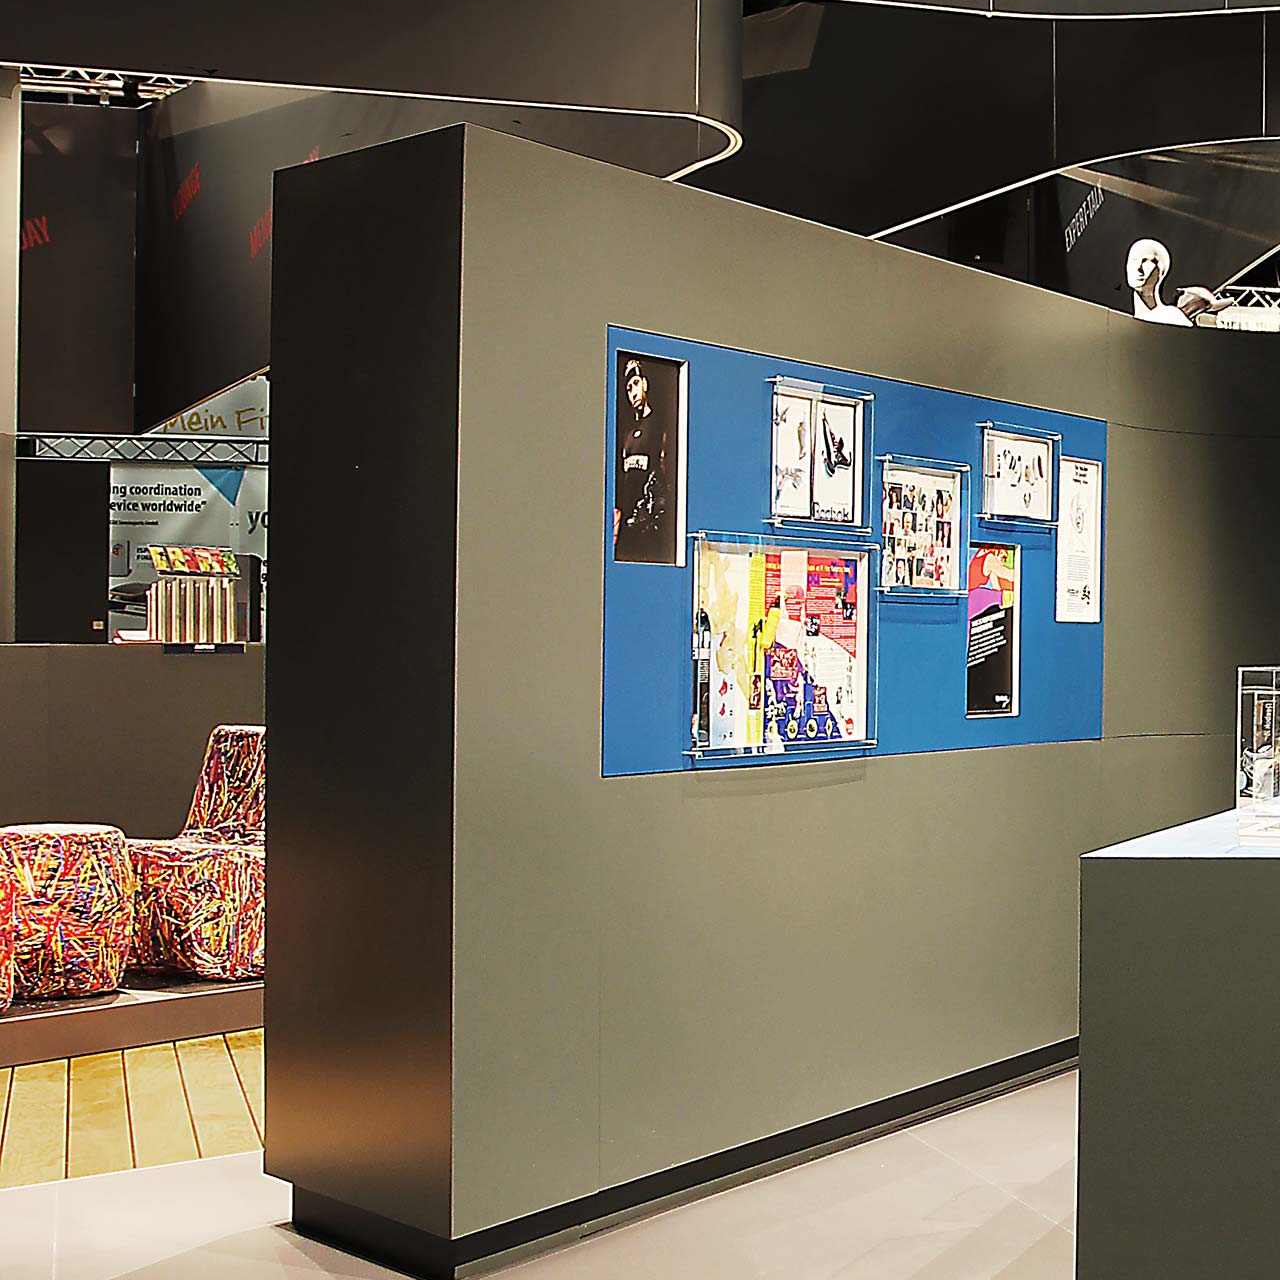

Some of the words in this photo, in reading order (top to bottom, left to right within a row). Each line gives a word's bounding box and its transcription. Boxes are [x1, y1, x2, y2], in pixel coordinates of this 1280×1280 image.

[1064, 178, 1105, 253] EXPERT-TALK
[235, 407, 268, 431] Fi
[129, 483, 202, 497] coordination
